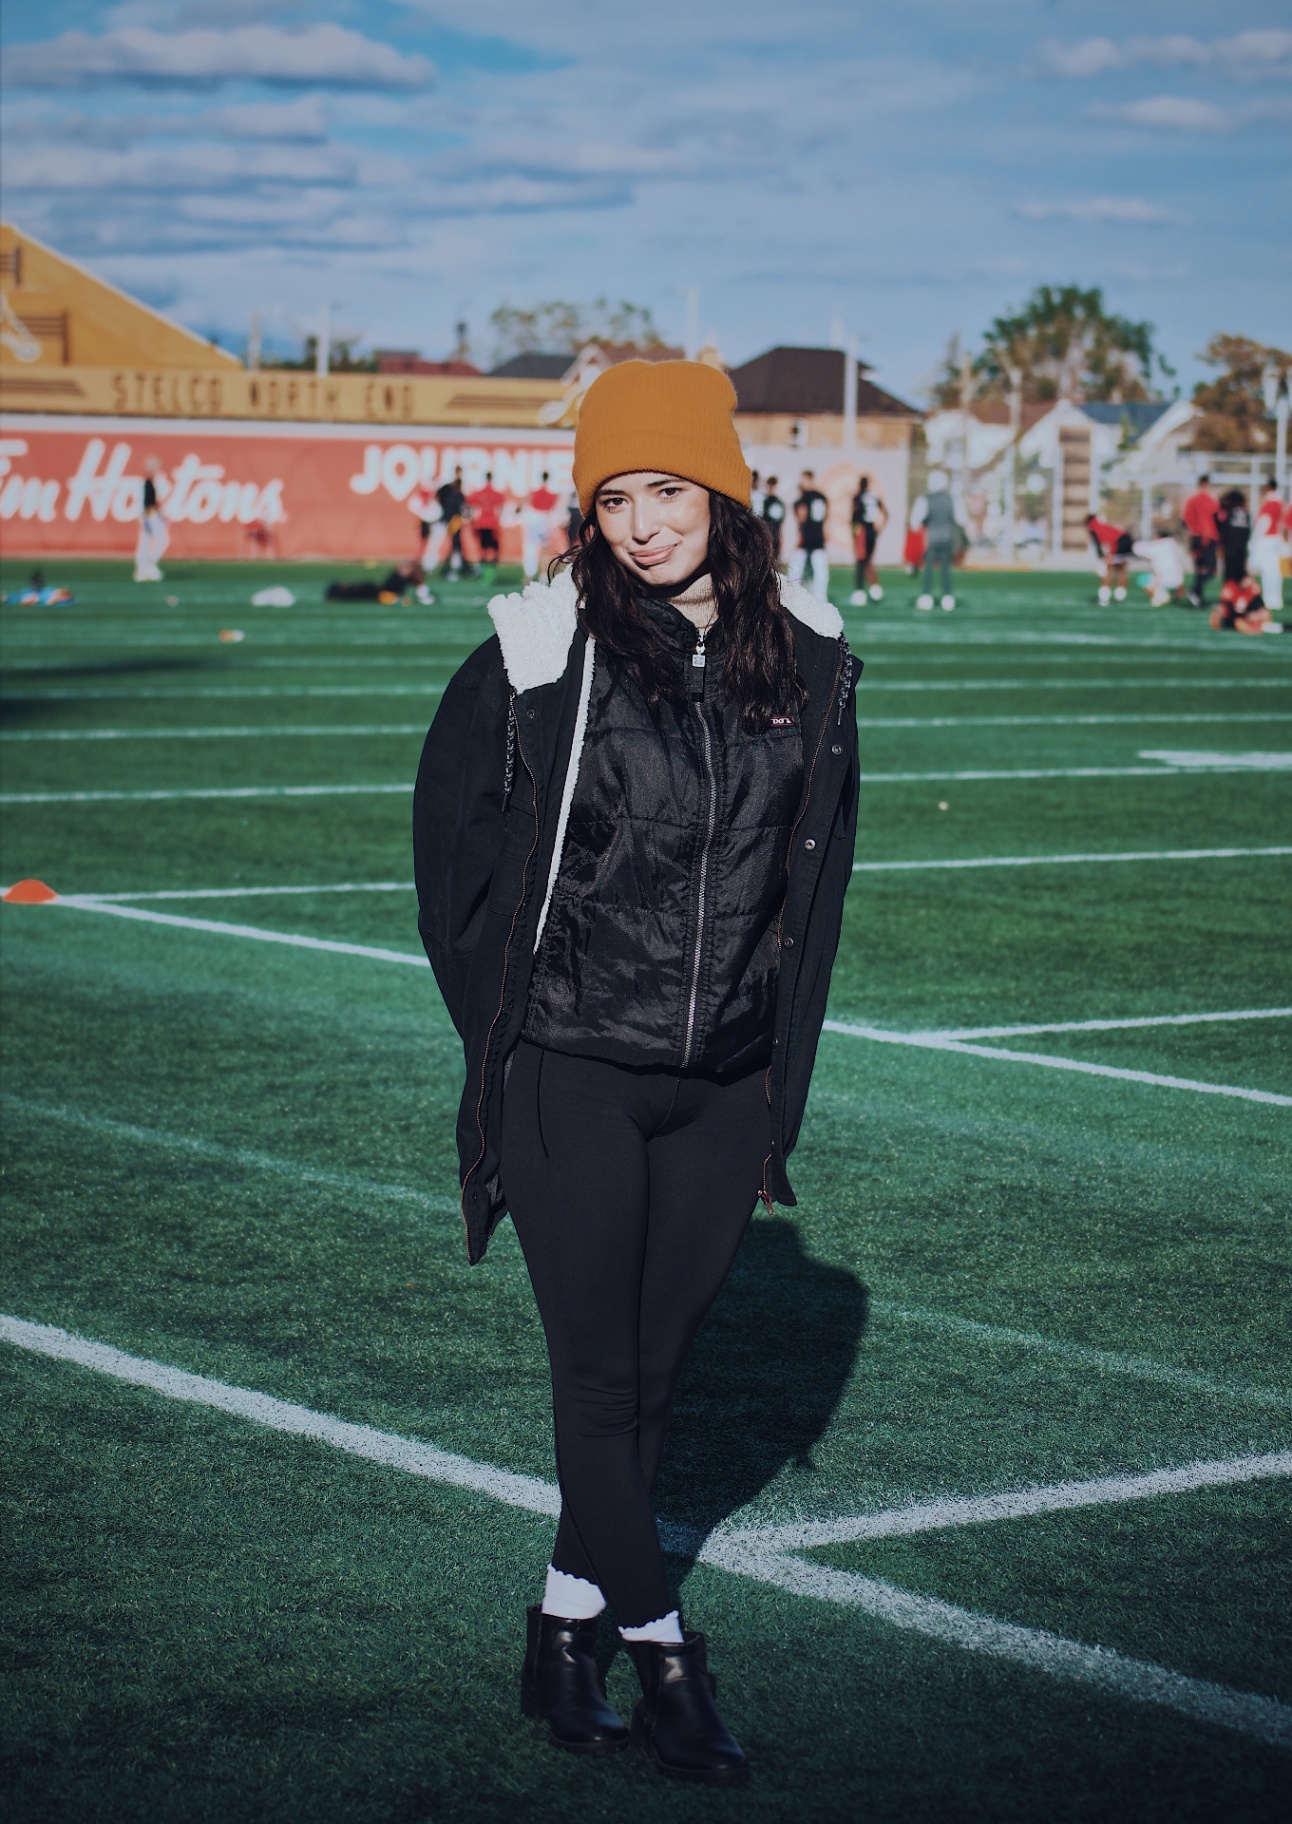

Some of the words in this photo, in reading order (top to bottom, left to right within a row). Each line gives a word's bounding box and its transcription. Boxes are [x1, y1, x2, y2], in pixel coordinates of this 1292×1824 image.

[111, 373, 222, 415] STELCO
[249, 377, 342, 418] NORTH
[364, 381, 417, 420] END
